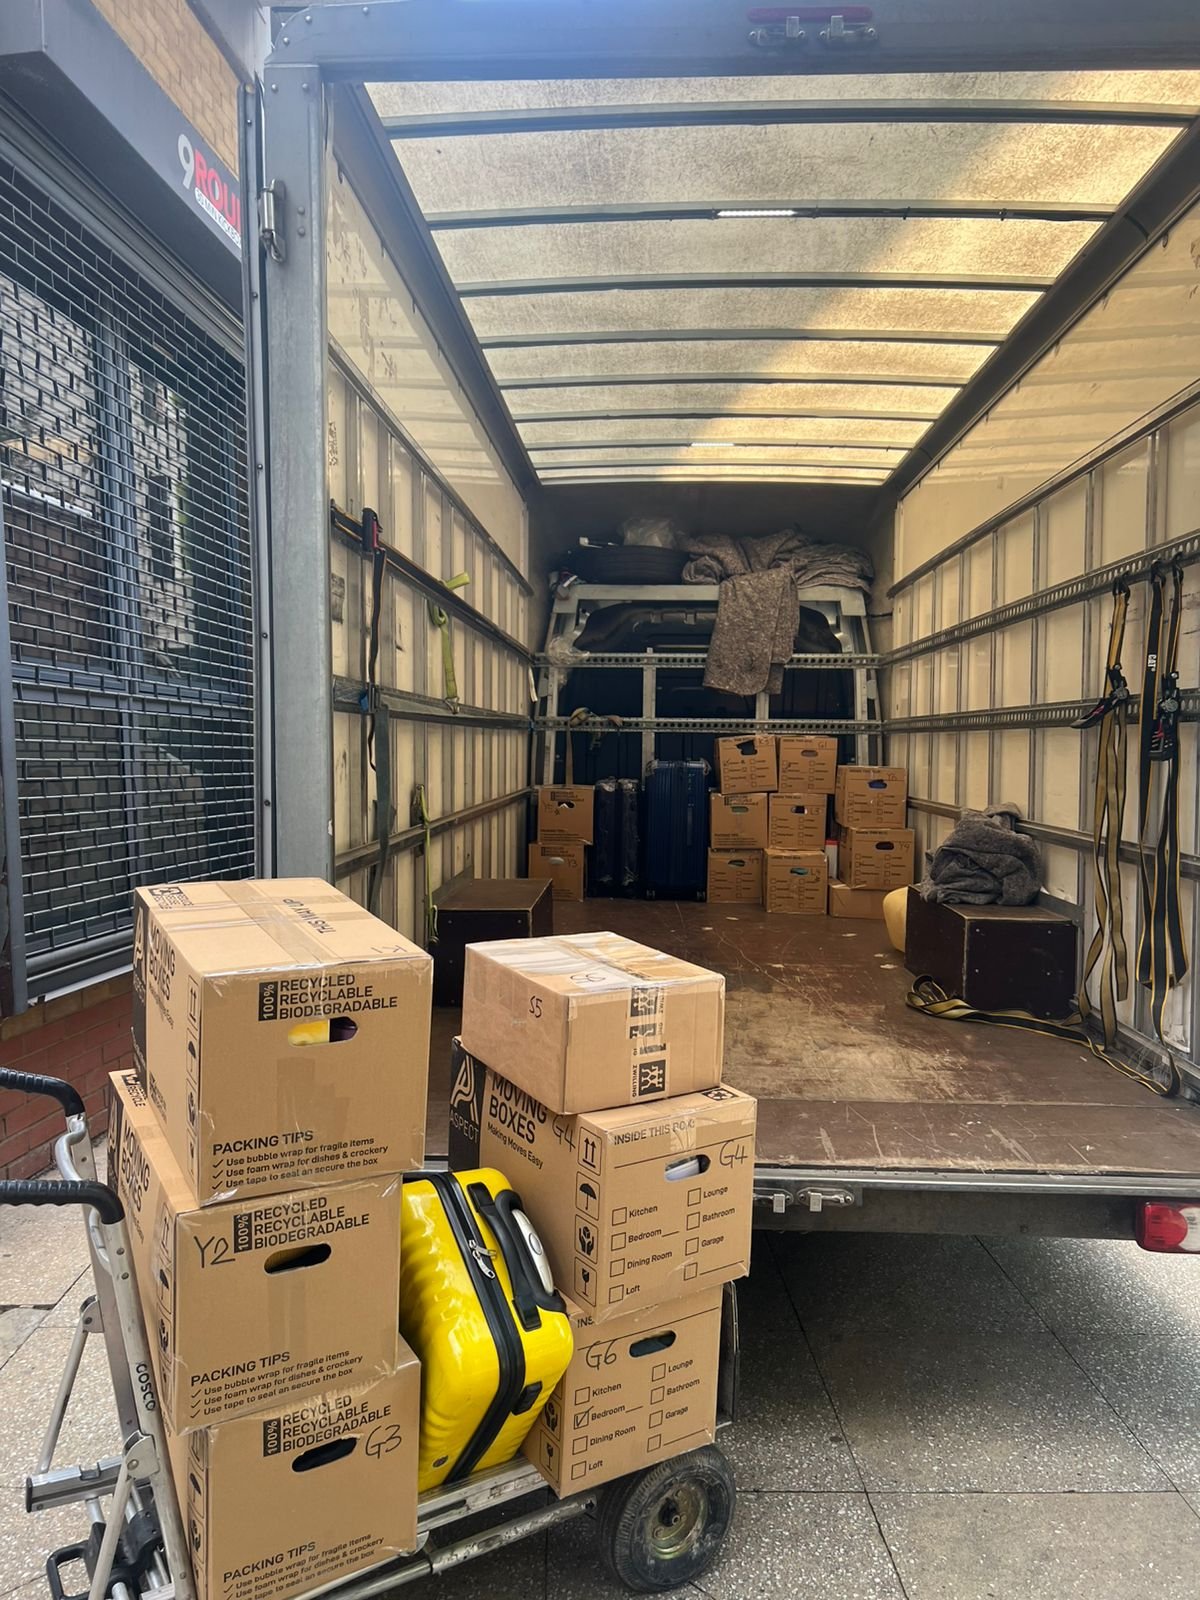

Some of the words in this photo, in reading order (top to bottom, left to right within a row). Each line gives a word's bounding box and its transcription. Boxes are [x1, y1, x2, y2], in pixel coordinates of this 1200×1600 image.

[280, 974, 355, 992] RECYCLED
[280, 985, 373, 1006] RECYCLABLE
[263, 983, 274, 1019] 100%
[279, 996, 398, 1020] BIODEGRADABLE
[529, 995, 542, 1018] S5
[449, 1110, 479, 1143] ASPECT
[489, 1095, 536, 1144] BOXES
[552, 1115, 576, 1153] G4
[614, 1127, 647, 1145] INSIDE
[649, 1124, 671, 1138] THIS
[213, 1135, 279, 1156] PACKING
[282, 1130, 313, 1145] TIPS
[226, 1157, 244, 1167] Use
[247, 1152, 278, 1163] bubble
[280, 1148, 303, 1159] wrap
[305, 1144, 318, 1154] for
[320, 1140, 348, 1154] fragile
[350, 1137, 374, 1147] items
[487, 1121, 507, 1145] Making
[507, 1137, 527, 1157] Moves
[527, 1150, 543, 1169] Easy
[720, 1140, 748, 1168] G4
[226, 1168, 244, 1178] Use
[247, 1164, 270, 1175] foam
[272, 1161, 295, 1172] wrap
[297, 1157, 310, 1167] for
[311, 1152, 340, 1163] dishes
[350, 1145, 388, 1158] crockery
[703, 1186, 728, 1199] Lounge
[254, 1197, 327, 1222] RECYCLED
[254, 1206, 345, 1236] RECYCLABLE
[629, 1205, 658, 1218] Kitchen
[702, 1207, 735, 1222] Bathroom
[238, 1213, 249, 1250] 100%
[254, 1213, 370, 1249] BIODEGRADABLE
[628, 1229, 662, 1243] Bedroom
[701, 1235, 724, 1248] Garage
[193, 1235, 236, 1269] Y2
[627, 1256, 650, 1270] Dining
[651, 1250, 673, 1263] Room
[626, 1284, 641, 1296] Loft
[191, 1360, 256, 1387] PACKING
[259, 1351, 291, 1369] TIPS
[586, 1339, 617, 1370] G6
[668, 1359, 693, 1373] Lounge
[136, 1363, 156, 1411] COSCO
[204, 1385, 223, 1396] Use
[224, 1377, 255, 1390] bubble
[257, 1369, 280, 1382] wrap
[282, 1365, 293, 1375] for
[296, 1358, 324, 1372] fragile
[325, 1350, 350, 1362] items
[204, 1395, 223, 1405] Use
[224, 1388, 248, 1400] foam
[249, 1381, 272, 1393] wrap
[273, 1377, 286, 1386] for
[288, 1368, 317, 1382] dishes
[326, 1355, 363, 1371] crockery
[666, 1378, 700, 1396] Bathroom
[203, 1405, 222, 1416] Use
[224, 1398, 245, 1411] tape
[247, 1394, 256, 1404] to
[257, 1389, 277, 1401] seal
[278, 1386, 290, 1395] an
[291, 1377, 321, 1391] secure
[323, 1372, 337, 1382] the
[338, 1367, 353, 1377] box
[592, 1383, 622, 1397] Kitchen
[283, 1395, 352, 1426] RECYCLED
[283, 1401, 369, 1439] RECYCLABLE
[591, 1405, 625, 1421] Bedroom
[665, 1406, 689, 1419] Garage
[267, 1420, 278, 1455] 100%
[282, 1405, 391, 1452] BIODEGRADABLE
[365, 1424, 402, 1459] G3
[590, 1431, 614, 1446] Dining
[614, 1425, 636, 1438] Room
[588, 1460, 603, 1471] Loft
[223, 1553, 284, 1583] PACKING
[287, 1541, 316, 1560] TIPS
[235, 1579, 253, 1590] Use
[254, 1567, 284, 1582] bubble
[285, 1558, 306, 1571] wrap
[308, 1554, 319, 1564] for
[321, 1543, 348, 1557] fragile
[349, 1534, 371, 1546] items
[235, 1588, 253, 1599] Use
[254, 1580, 276, 1591] foam
[278, 1571, 299, 1584] wrap
[301, 1565, 312, 1575] for
[314, 1556, 341, 1569] dishes
[349, 1537, 384, 1555] crockery
